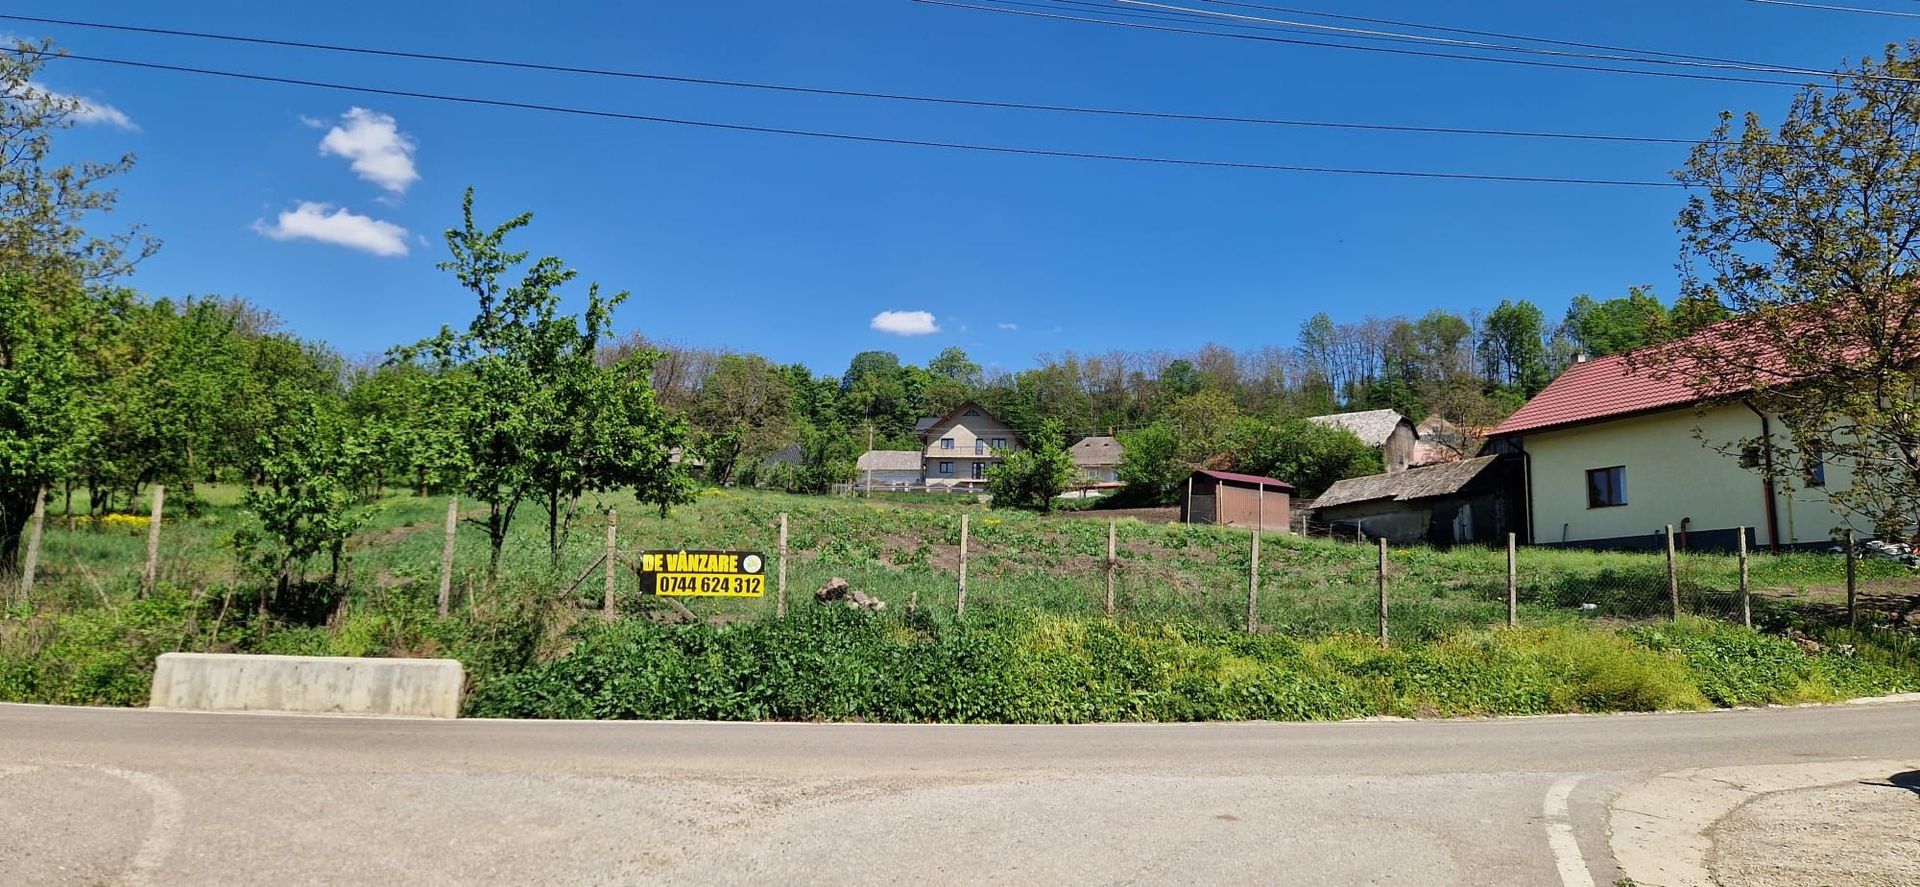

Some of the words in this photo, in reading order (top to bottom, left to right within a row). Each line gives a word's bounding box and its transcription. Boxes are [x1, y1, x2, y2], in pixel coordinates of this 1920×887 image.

[643, 554, 663, 571] DE
[666, 549, 738, 572] VÂNZARE
[660, 576, 696, 593] 0744
[701, 576, 730, 593] 624
[734, 577, 761, 593] 312
